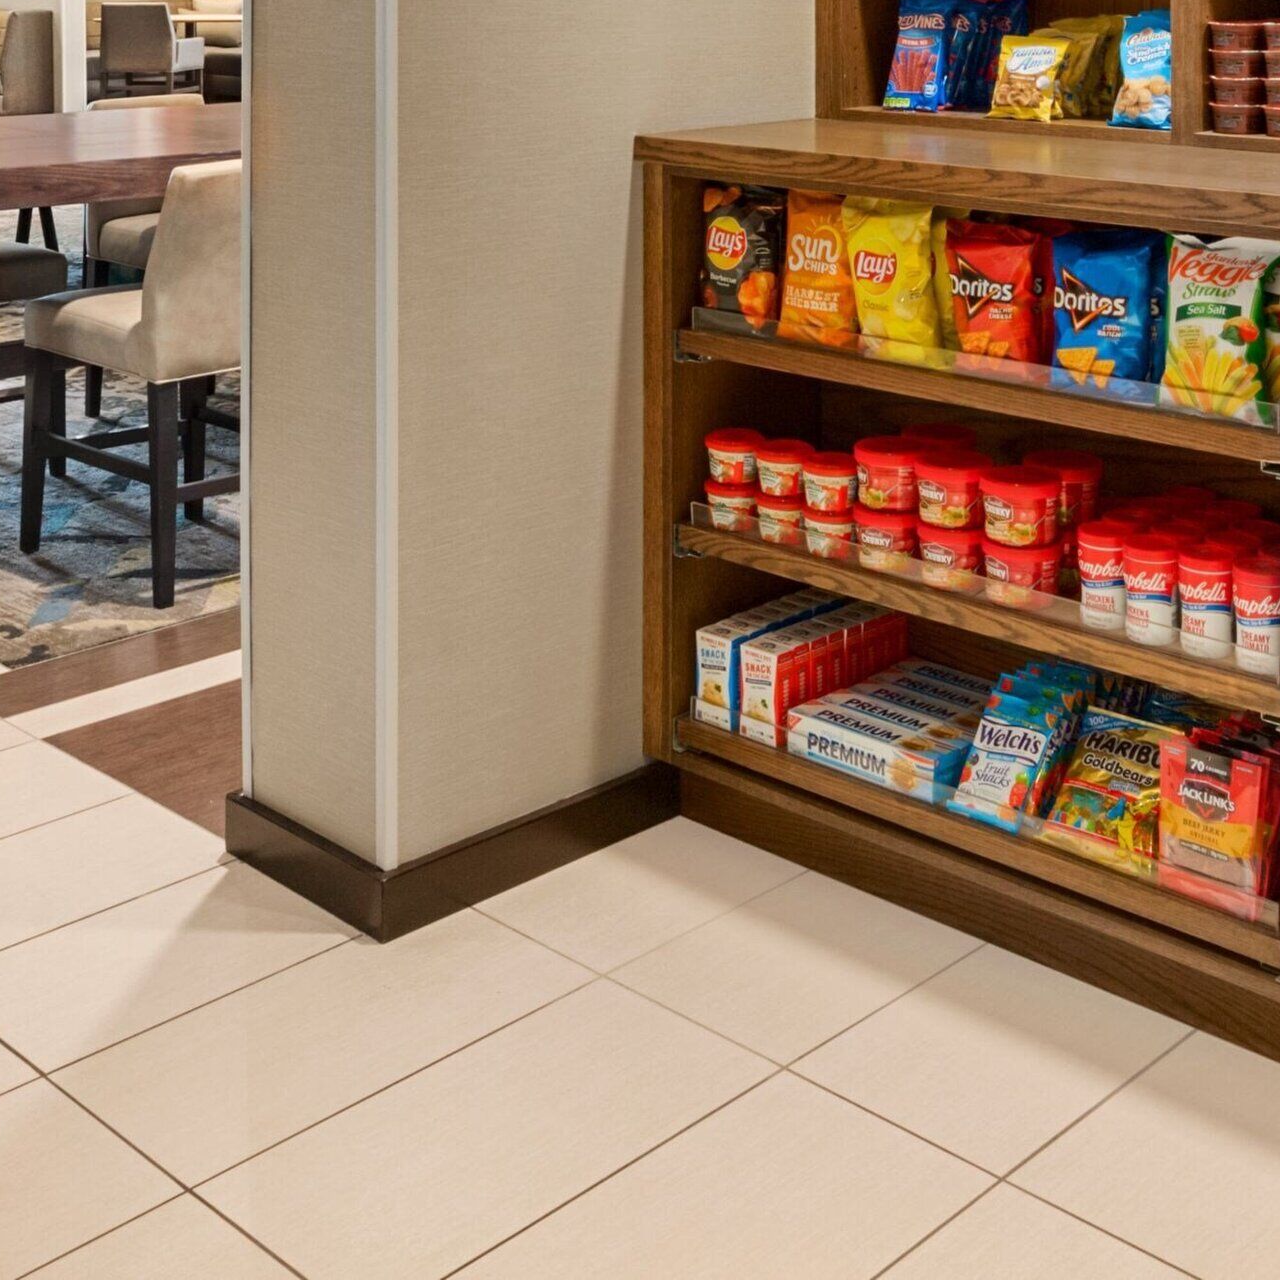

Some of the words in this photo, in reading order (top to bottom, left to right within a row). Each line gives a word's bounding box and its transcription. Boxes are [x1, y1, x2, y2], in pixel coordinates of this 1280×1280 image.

[914, 14, 945, 30] VINES
[708, 227, 745, 256] Lay's
[788, 233, 840, 272] Sun
[804, 260, 837, 275] CHIPS
[856, 251, 896, 284] Lay's
[1169, 247, 1267, 287] Veggie
[786, 286, 840, 302] HARVEST
[951, 274, 1014, 302] Doritos
[1054, 287, 1126, 316] Doritos
[1187, 304, 1202, 315] Sea
[1205, 304, 1226, 315] Salt
[1179, 582, 1227, 601] mpbell's
[701, 648, 726, 659] SNACK
[746, 663, 771, 673] SNACK
[873, 688, 957, 718] PREMIUM
[896, 677, 980, 706] PREMIUM
[818, 710, 902, 741] PREMIUM
[845, 698, 929, 729] PREMIUM
[980, 723, 1041, 754] Welch's
[808, 732, 886, 776] PREMIUM
[984, 762, 1010, 774] Fruit
[1189, 758, 1204, 772] 70
[974, 769, 1011, 787] Snacks
[1083, 754, 1153, 786] Goldbears
[1178, 784, 1203, 803] JACK
[1204, 795, 1235, 812] LINK'S
[1183, 818, 1201, 829] BEEF
